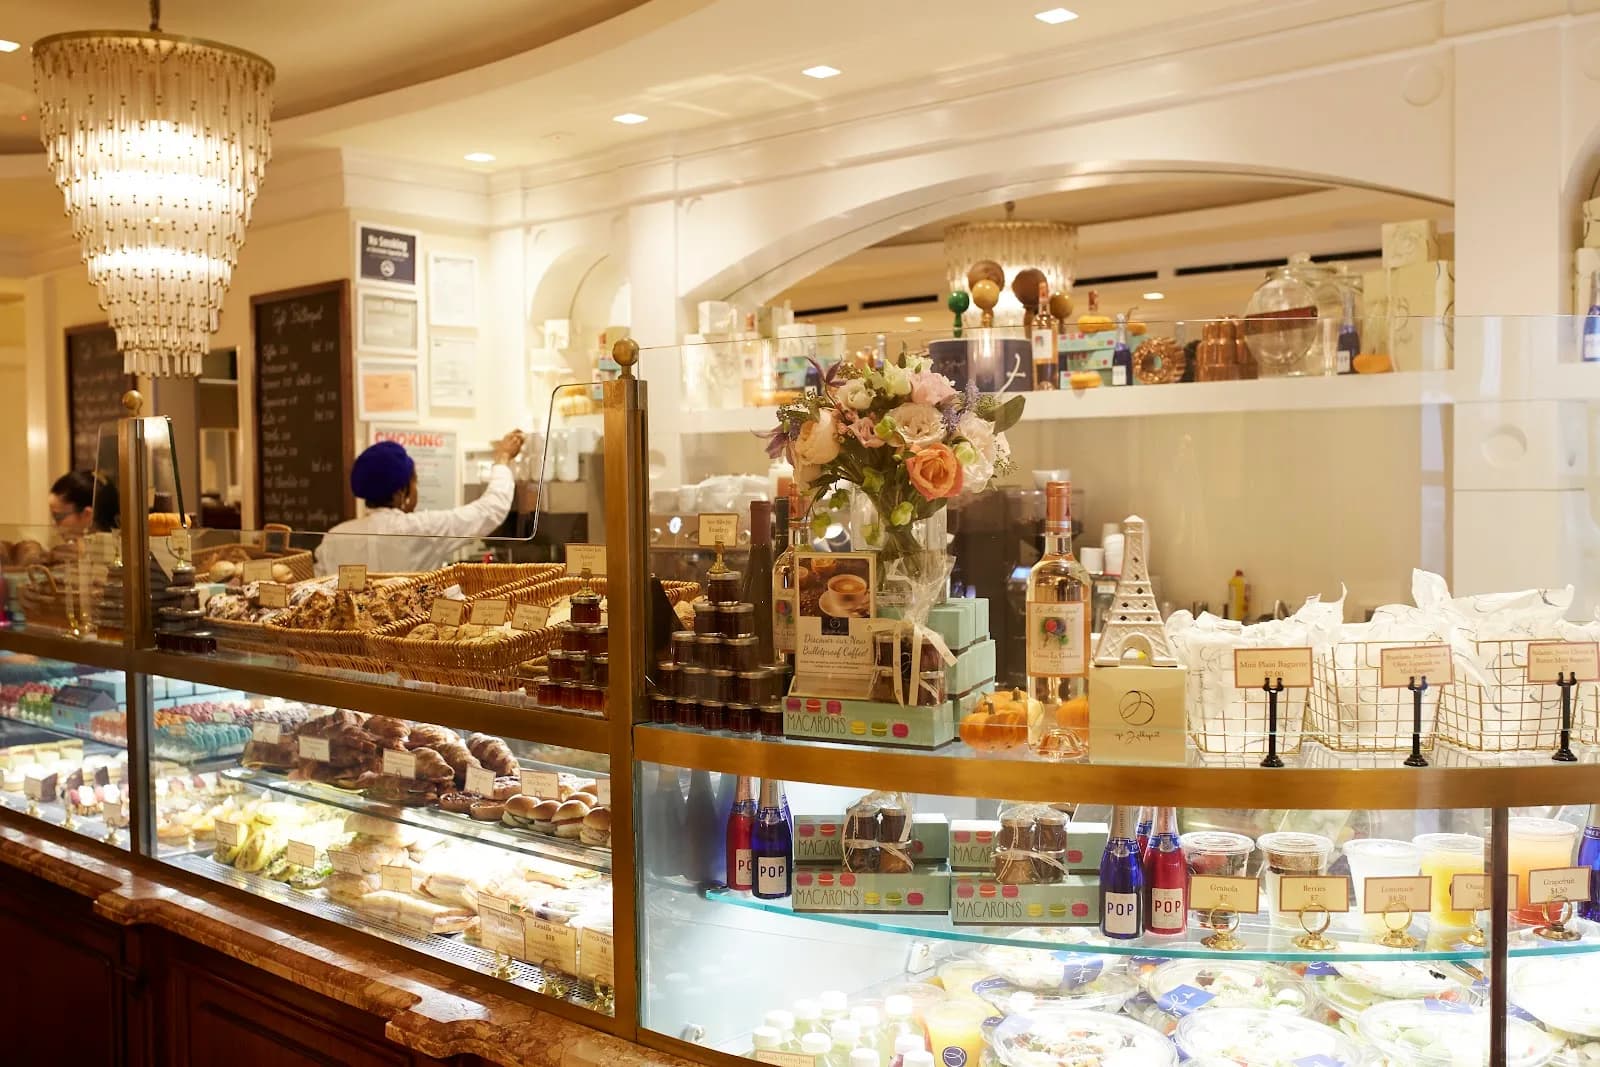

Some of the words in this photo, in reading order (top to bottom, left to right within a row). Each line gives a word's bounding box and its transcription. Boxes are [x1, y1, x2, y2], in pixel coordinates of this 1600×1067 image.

[804, 633, 833, 644] Discover
[803, 645, 841, 658] Bulletproof
[786, 713, 847, 735] MACARONS
[738, 859, 752, 871] PO
[760, 865, 785, 878] POP
[795, 888, 860, 906] MACARONS
[956, 901, 1023, 919] MACARONS
[1107, 902, 1135, 916] POP
[1154, 900, 1182, 914] POP
